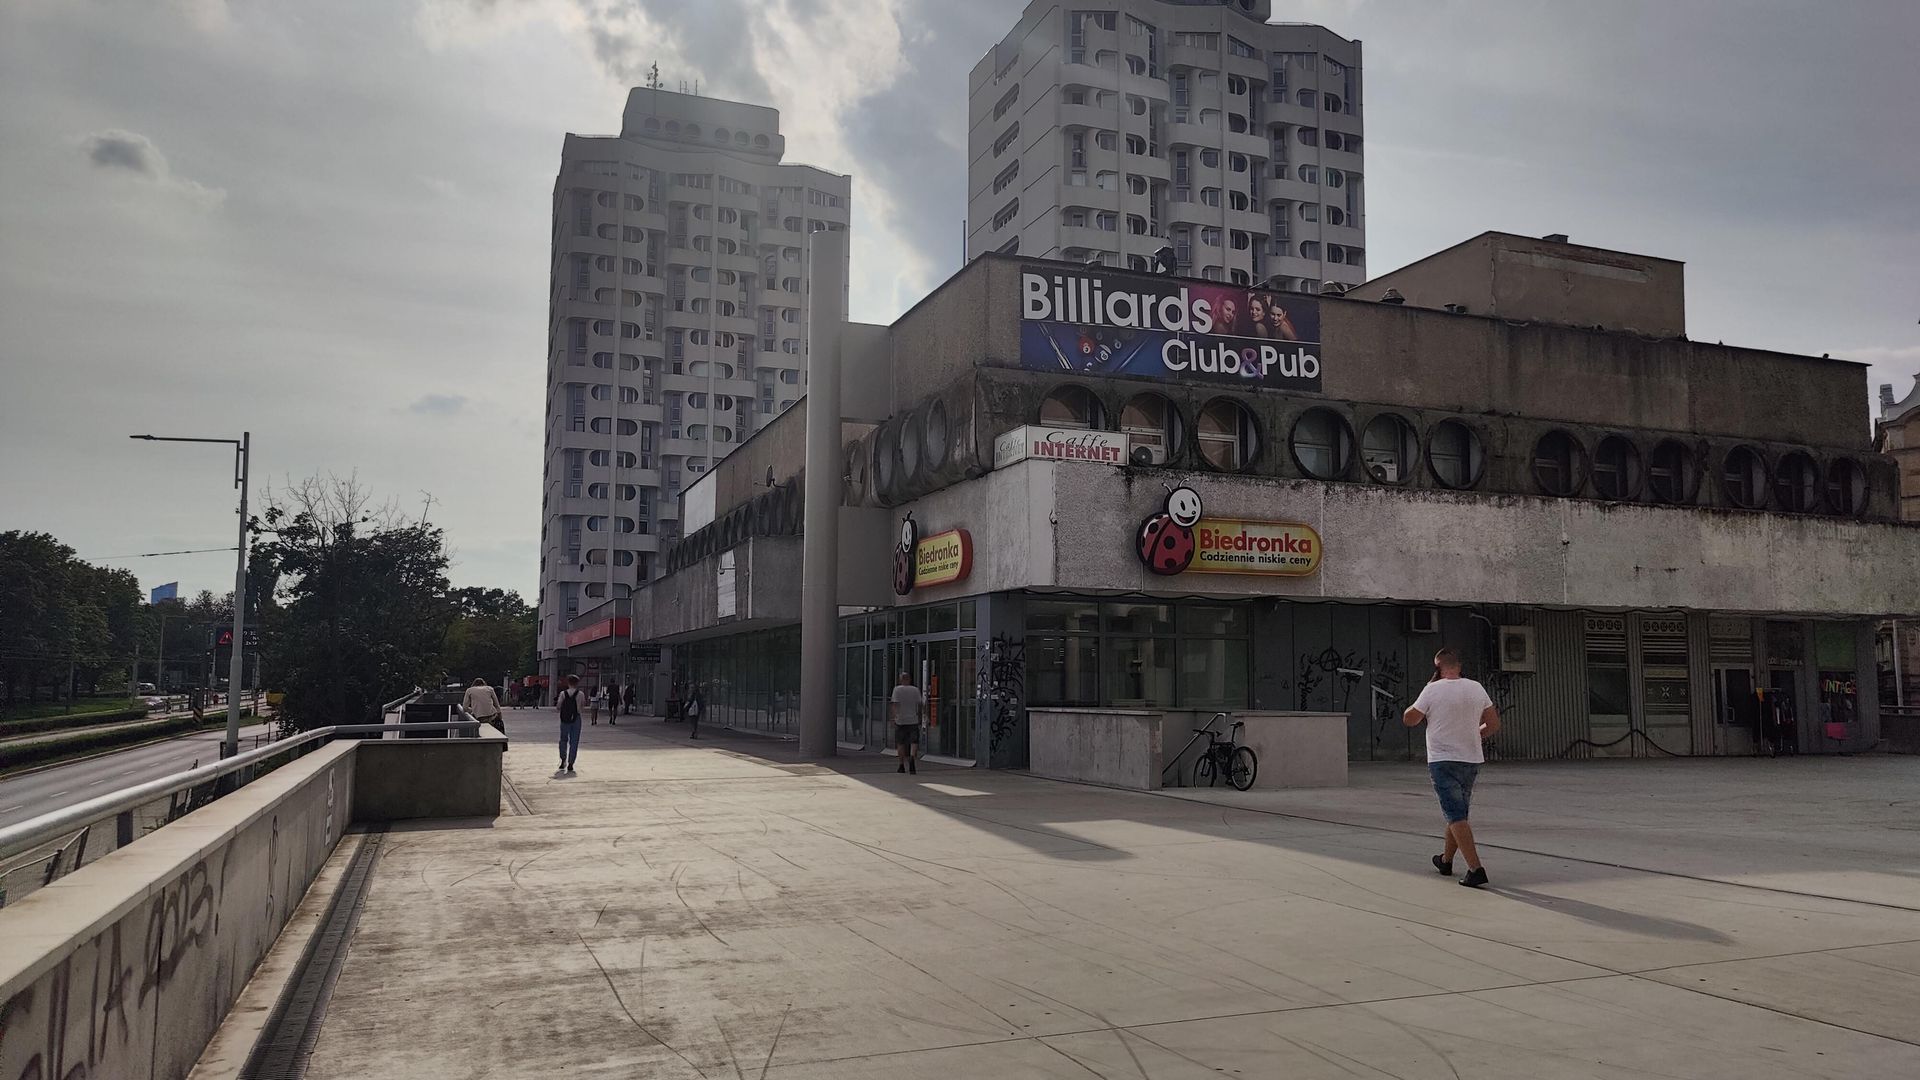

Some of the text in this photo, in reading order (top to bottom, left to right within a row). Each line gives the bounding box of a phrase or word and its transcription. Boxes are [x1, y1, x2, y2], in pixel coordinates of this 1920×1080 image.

[1022, 273, 1213, 334] Billiards
[1046, 431, 1109, 449] Caffe
[1034, 441, 1121, 462] INTERNET
[1199, 529, 1312, 553] Biedronka
[918, 541, 959, 565] Biedronka
[1200, 550, 1312, 567] Codziennie niskie ceny
